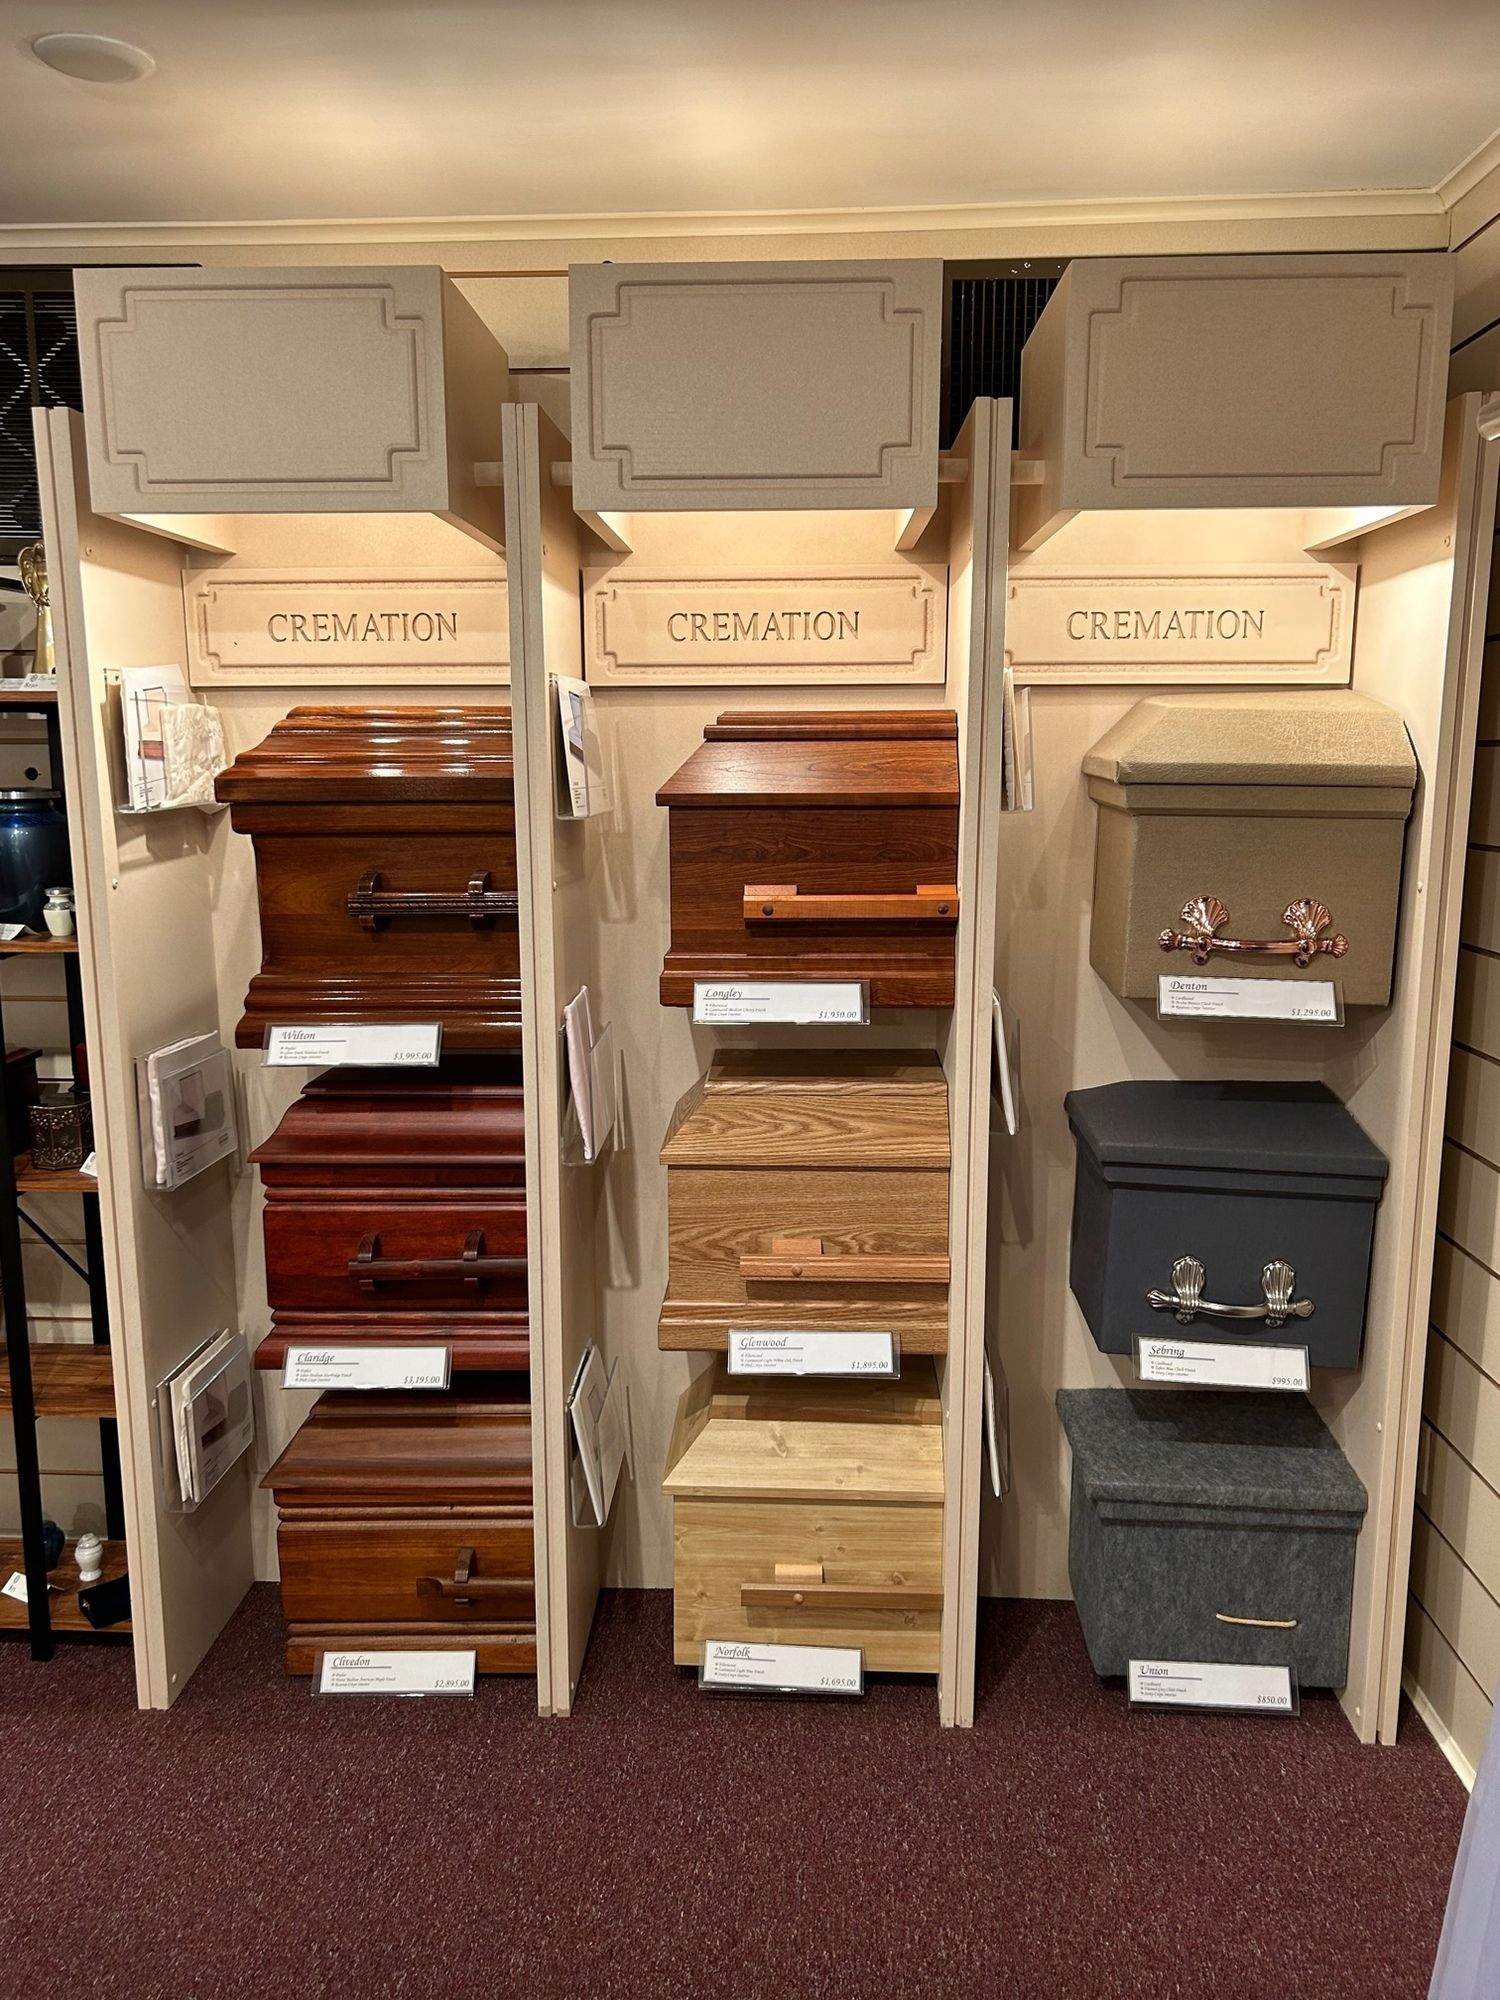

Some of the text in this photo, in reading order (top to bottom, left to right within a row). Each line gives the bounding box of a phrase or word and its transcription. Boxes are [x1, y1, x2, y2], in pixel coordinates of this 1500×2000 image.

[268, 612, 457, 642] CREMATION
[667, 611, 860, 642] CREMATION
[1066, 609, 1265, 641] CREMATION
[1170, 981, 1208, 991] Denton
[705, 987, 743, 1000] Longley
[818, 1010, 857, 1019] $1,950.00
[1291, 1008, 1332, 1017] $1,295.00
[282, 1030, 316, 1040] Wilton
[393, 1051, 433, 1060] $3,995.00
[740, 1336, 789, 1349] Glenwood
[1149, 1345, 1185, 1359] Sebring
[297, 1351, 336, 1365] Claridge
[851, 1360, 889, 1370] $1,895.00
[403, 1375, 441, 1384] $3,195.00
[1272, 1376, 1303, 1386] $995.00
[714, 1646, 752, 1660] Norfolk
[332, 1655, 371, 1669] Clivedon
[1140, 1664, 1169, 1675] Union
[434, 1679, 470, 1688] $2,895.00
[820, 1676, 857, 1687] $1,695.00
[1257, 1695, 1288, 1704] $850.00
